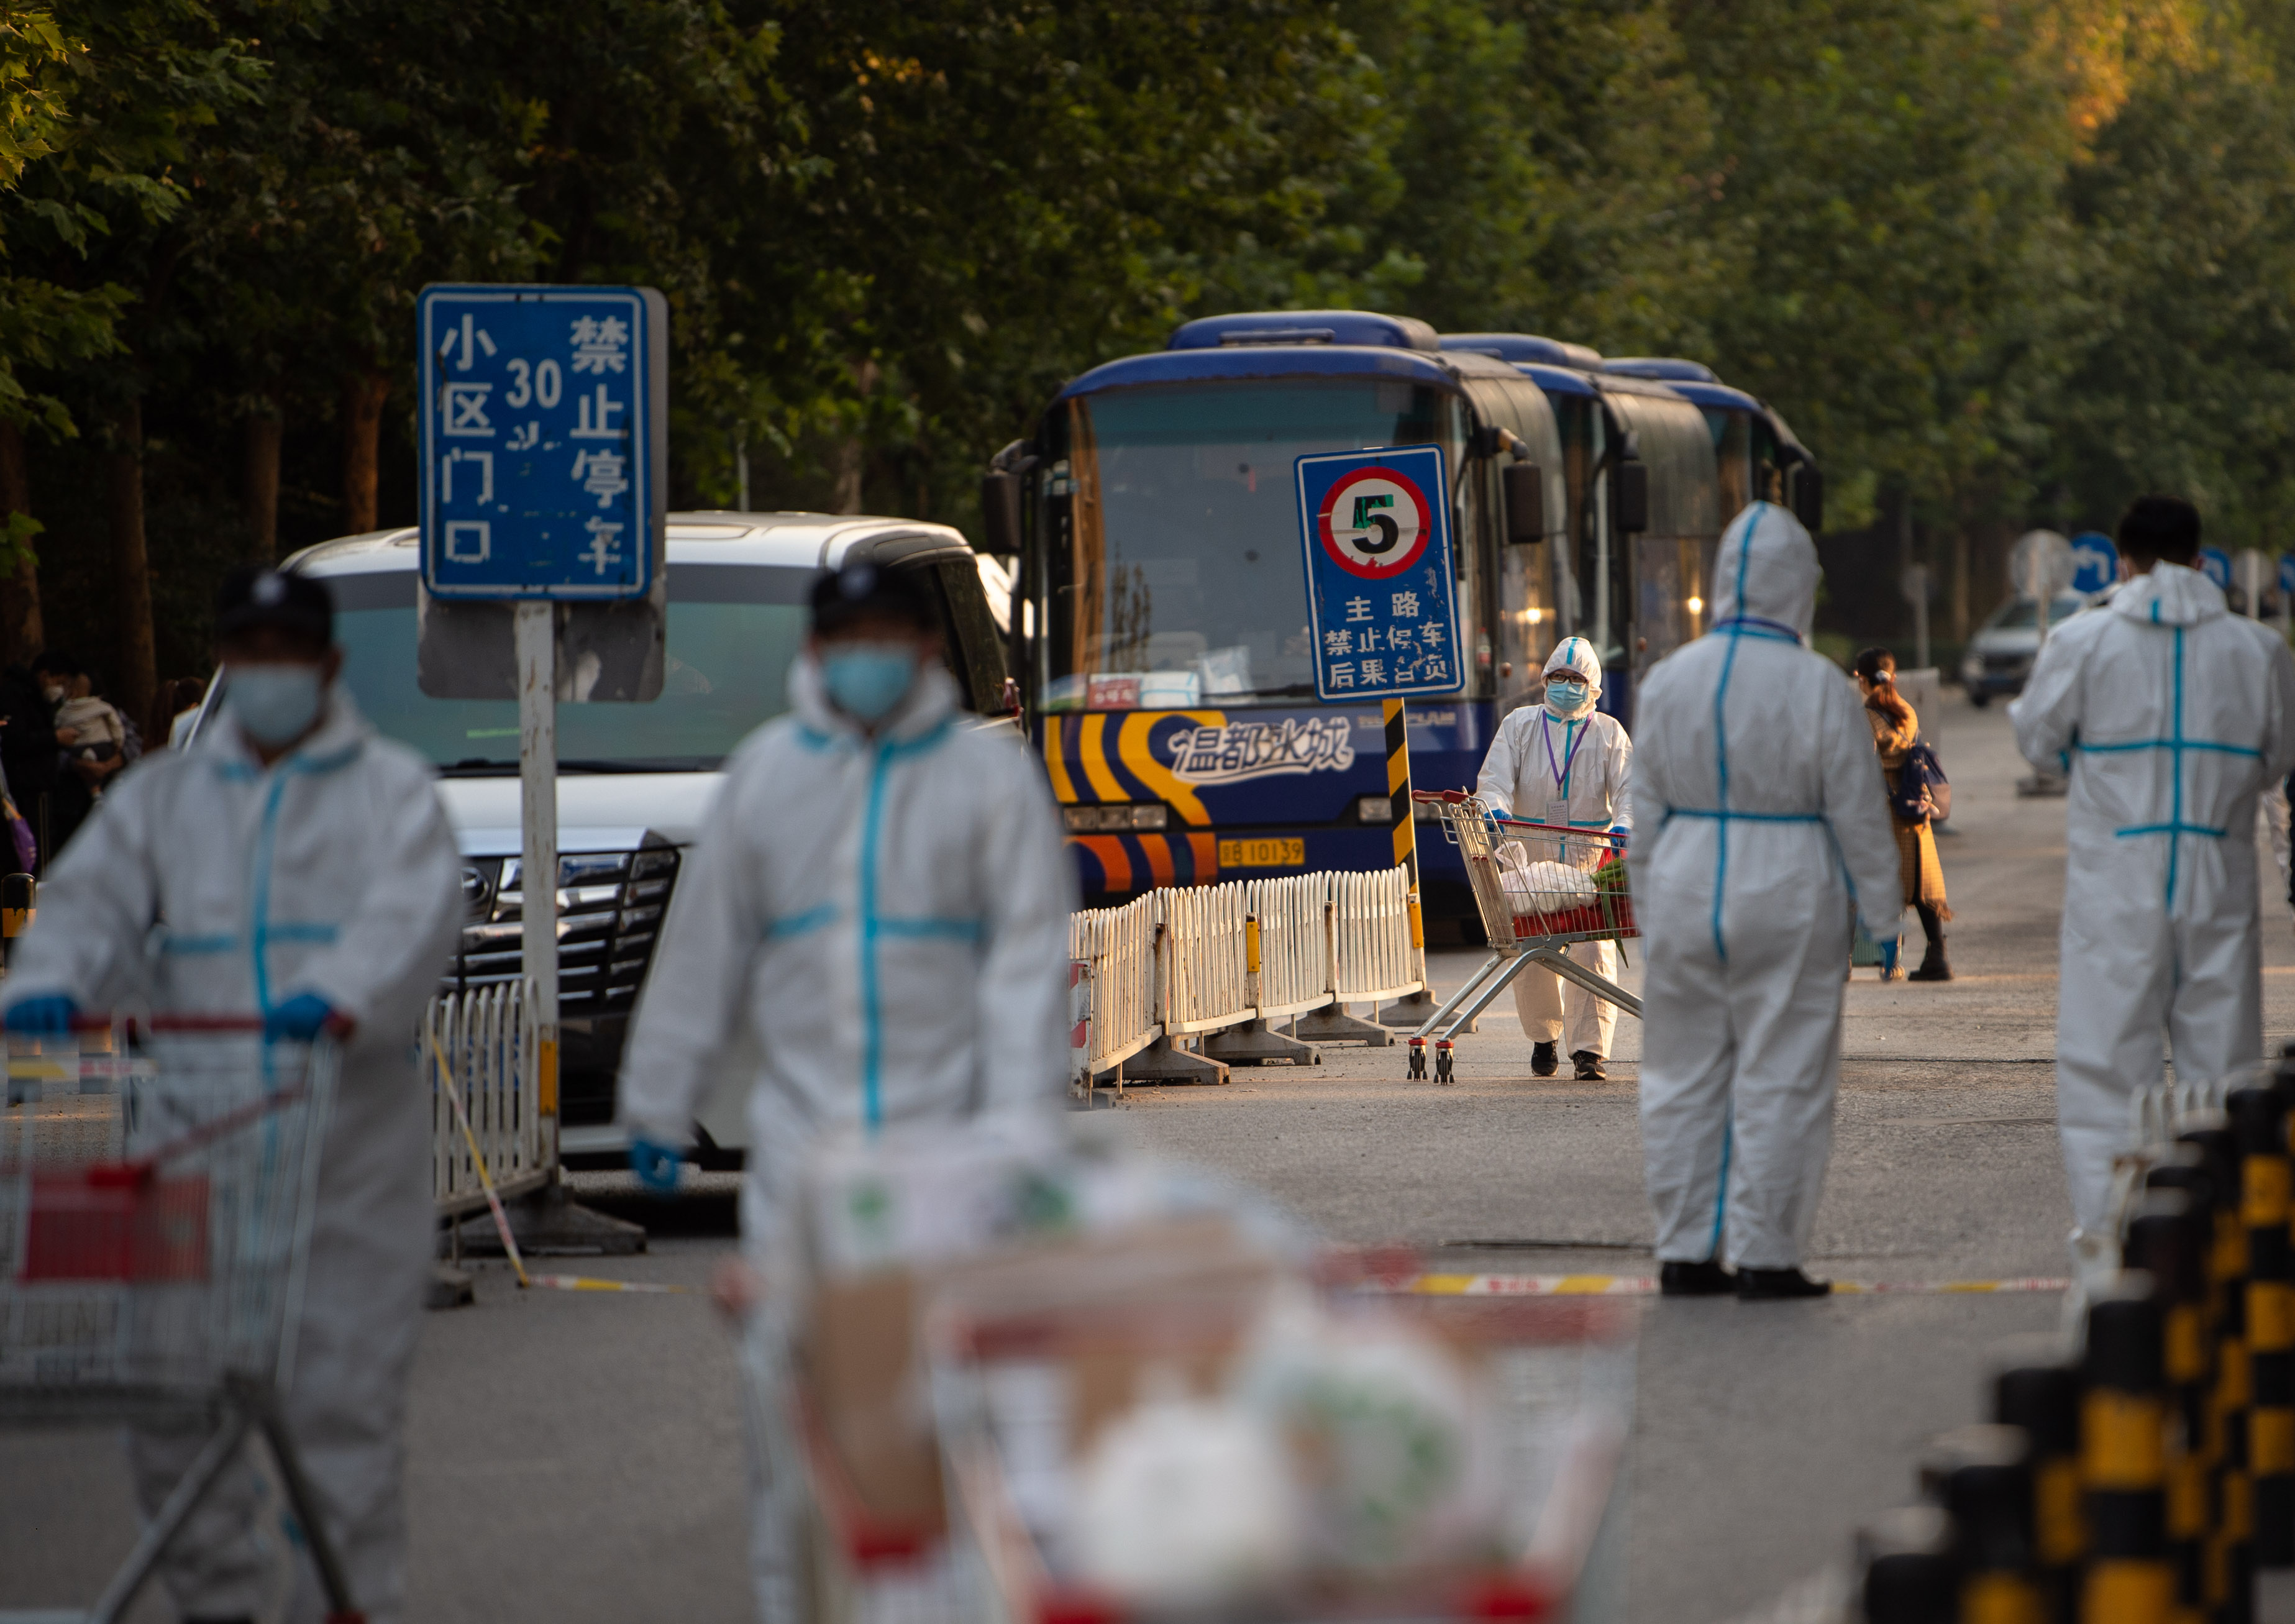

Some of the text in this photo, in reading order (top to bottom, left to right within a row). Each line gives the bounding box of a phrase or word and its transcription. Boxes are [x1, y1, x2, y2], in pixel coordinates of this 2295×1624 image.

[505, 357, 562, 409] 30
[439, 313, 498, 562] 小区门口
[569, 315, 629, 575] 禁止停车
[1351, 494, 1399, 555] 5
[1325, 621, 1446, 655] 禁止停车
[1169, 717, 1356, 775] 温都水城
